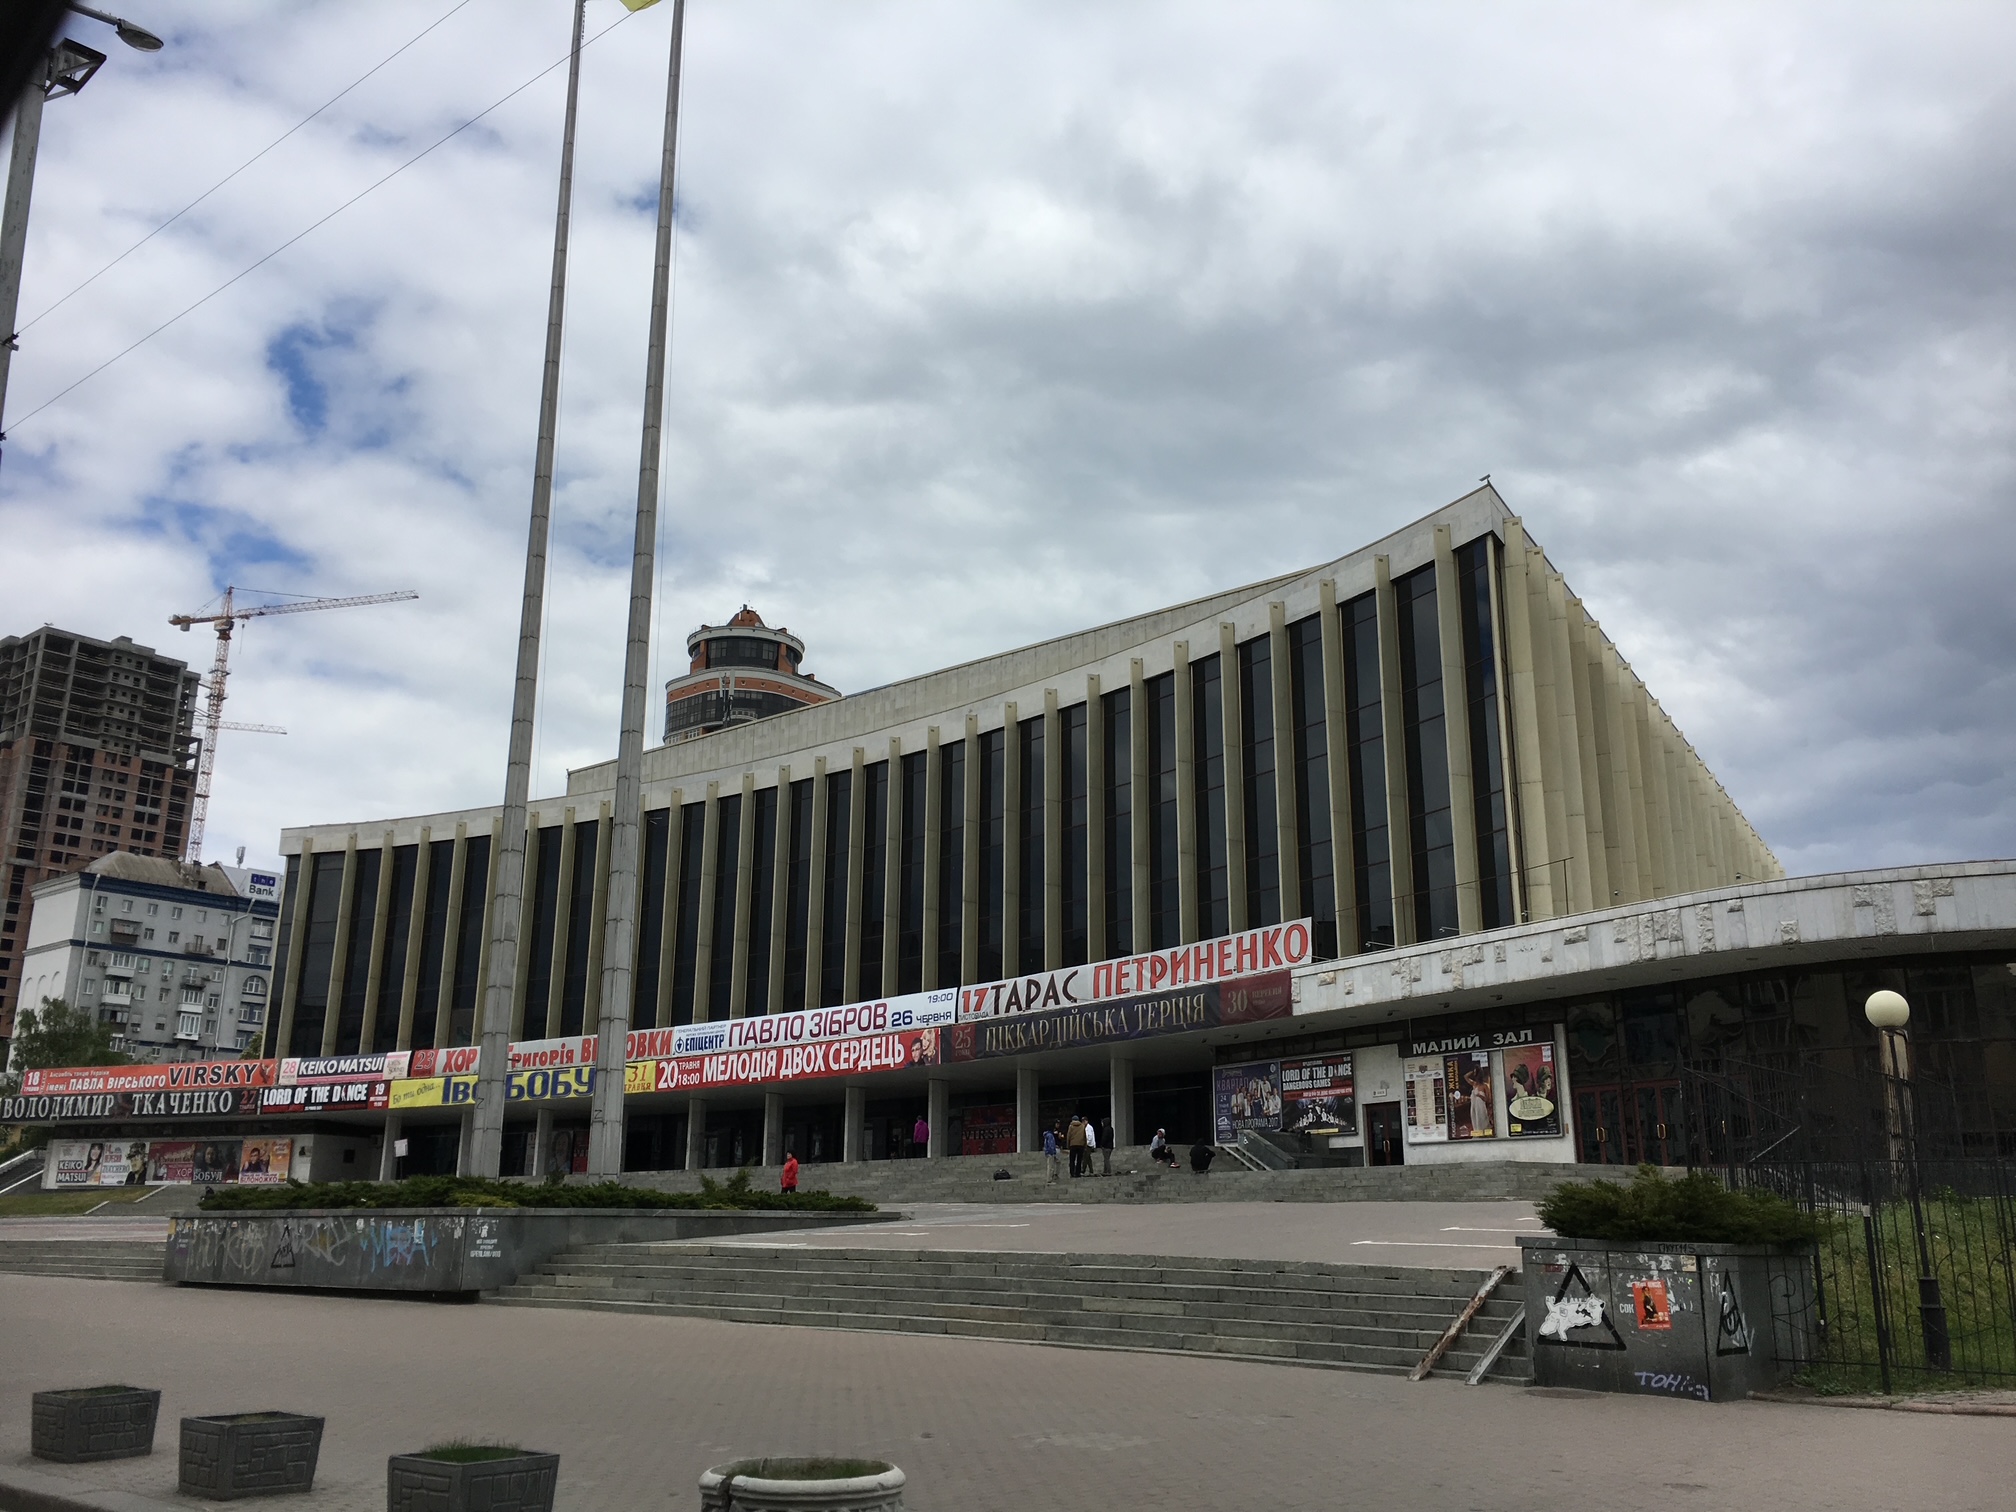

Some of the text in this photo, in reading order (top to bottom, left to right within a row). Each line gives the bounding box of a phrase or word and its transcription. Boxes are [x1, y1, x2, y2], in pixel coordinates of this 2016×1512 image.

[253, 876, 274, 885] the
[249, 885, 274, 898] Bank
[1092, 923, 1309, 999] ПЕТРИНЕНКО
[927, 992, 954, 1004] 19:00
[962, 988, 989, 1013] 17
[990, 969, 1078, 1016] ТАРАС
[1227, 989, 1248, 1014] 30
[729, 1002, 952, 1048] ПАВЛО ЗІБРОВ 26 ЧЕРВНЯ
[985, 992, 1206, 1052] ПІККАРДІЙСЬКА ТЕРЦІЯ
[684, 1034, 725, 1053] ЕПІЦЕНТР
[956, 1027, 972, 1049] 25
[1412, 1029, 1533, 1055] МАЛИЙ ЗАЛ
[283, 1061, 297, 1074] 28
[299, 1060, 338, 1075] KEIKO
[338, 1057, 385, 1073] MATSUI
[415, 1050, 435, 1070] 23
[443, 1048, 478, 1073] ХОР
[679, 1061, 701, 1071] ТРАВНЯ
[703, 1034, 905, 1083] МЕЛОДІЯ ДВОХ СЕРДЕЦЬ
[28, 1071, 41, 1086] 18
[69, 1077, 104, 1091] ПАВЛА
[107, 1074, 166, 1090] ВІРСЬКОГО
[168, 1063, 261, 1087] VIRSKY
[628, 1065, 648, 1083] 31
[658, 1060, 679, 1089] 20
[678, 1073, 700, 1087] 18:00
[1282, 1069, 1300, 1082] LORD
[1301, 1067, 1311, 1080] OF
[1312, 1065, 1326, 1079] THE
[375, 1083, 385, 1096] 19
[505, 1068, 597, 1102] БОБУ
[1282, 1078, 1331, 1091] DANGEROUS GAMES
[240, 1090, 257, 1105] 27
[263, 1088, 292, 1106] LORD
[294, 1086, 308, 1104] OF
[311, 1086, 330, 1103] THE
[2, 1094, 116, 1121] ВОЛОДИМИР
[132, 1090, 233, 1115] ТКАЧЕНКО
[962, 1126, 1016, 1141] VIRSKY
[59, 1161, 83, 1170] KEIKO
[176, 1168, 192, 1177] ХОР
[57, 1172, 87, 1182] MATSUI
[193, 1171, 223, 1182] БОБУЛ
